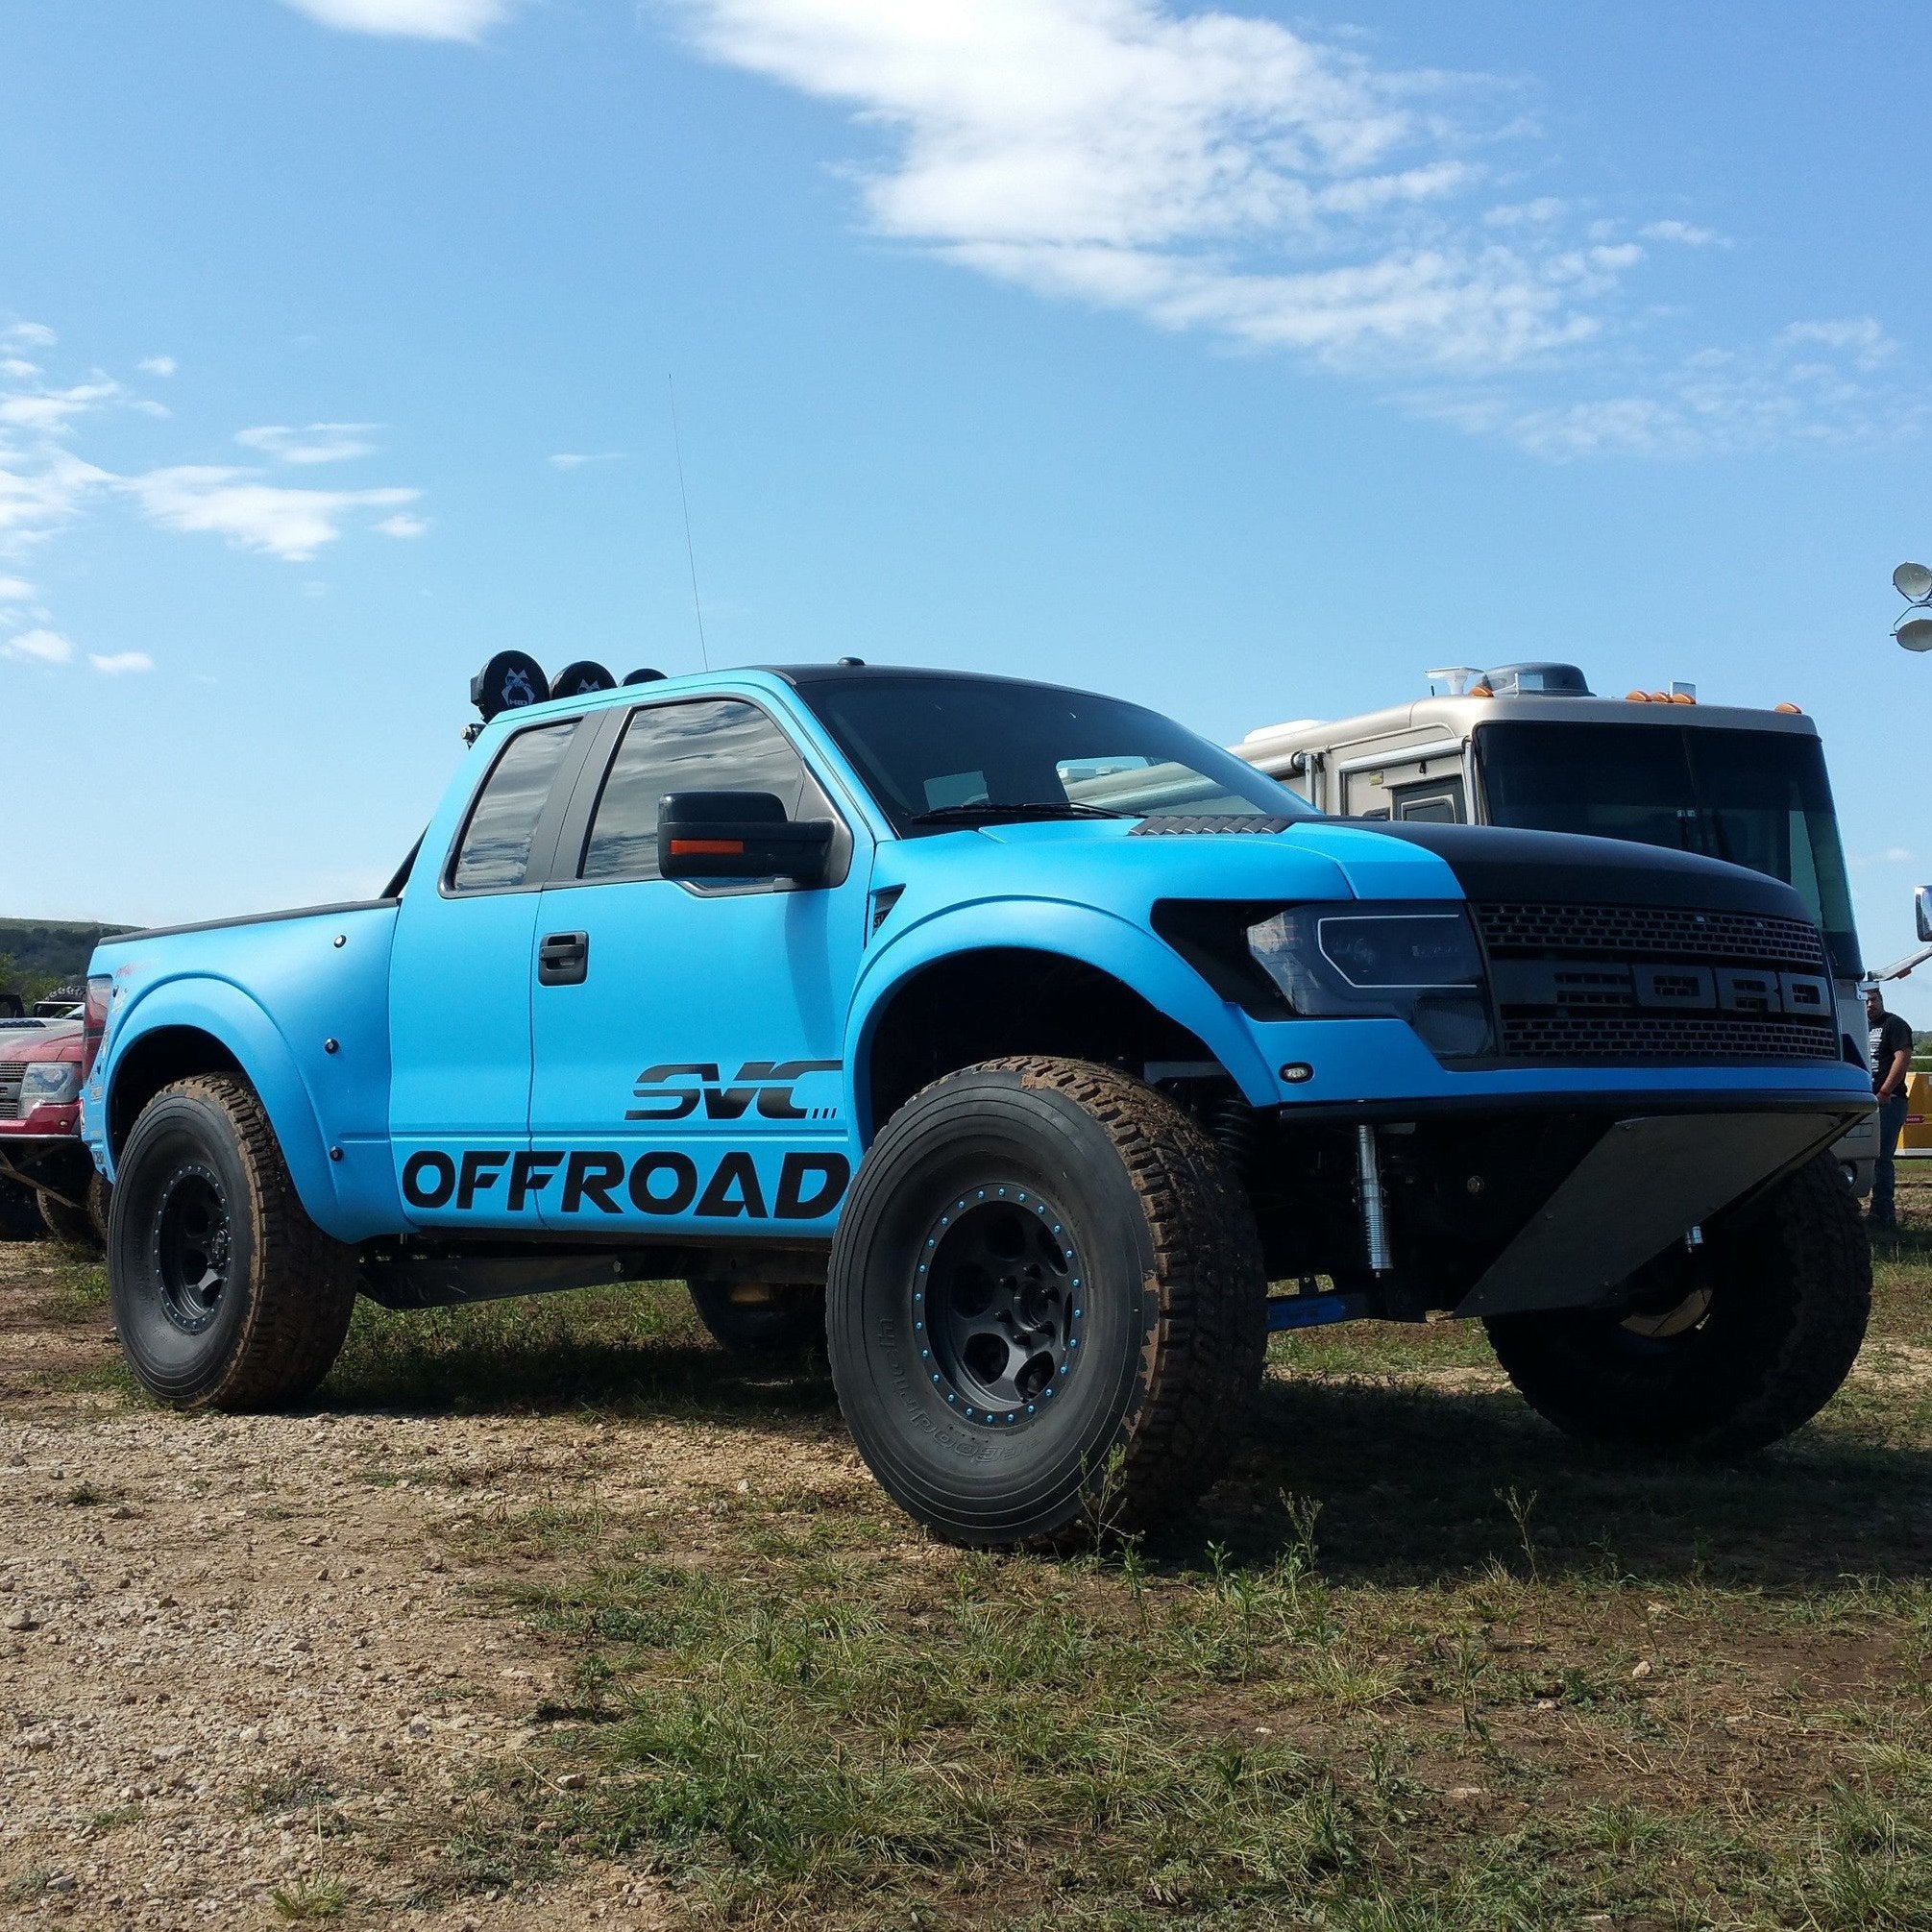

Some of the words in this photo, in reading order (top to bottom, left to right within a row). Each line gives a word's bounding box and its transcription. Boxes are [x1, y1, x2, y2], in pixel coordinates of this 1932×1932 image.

[1491, 959, 1831, 1016] FORD
[624, 1060, 843, 1120] SVC
[402, 1150, 851, 1219] OFFROAD
